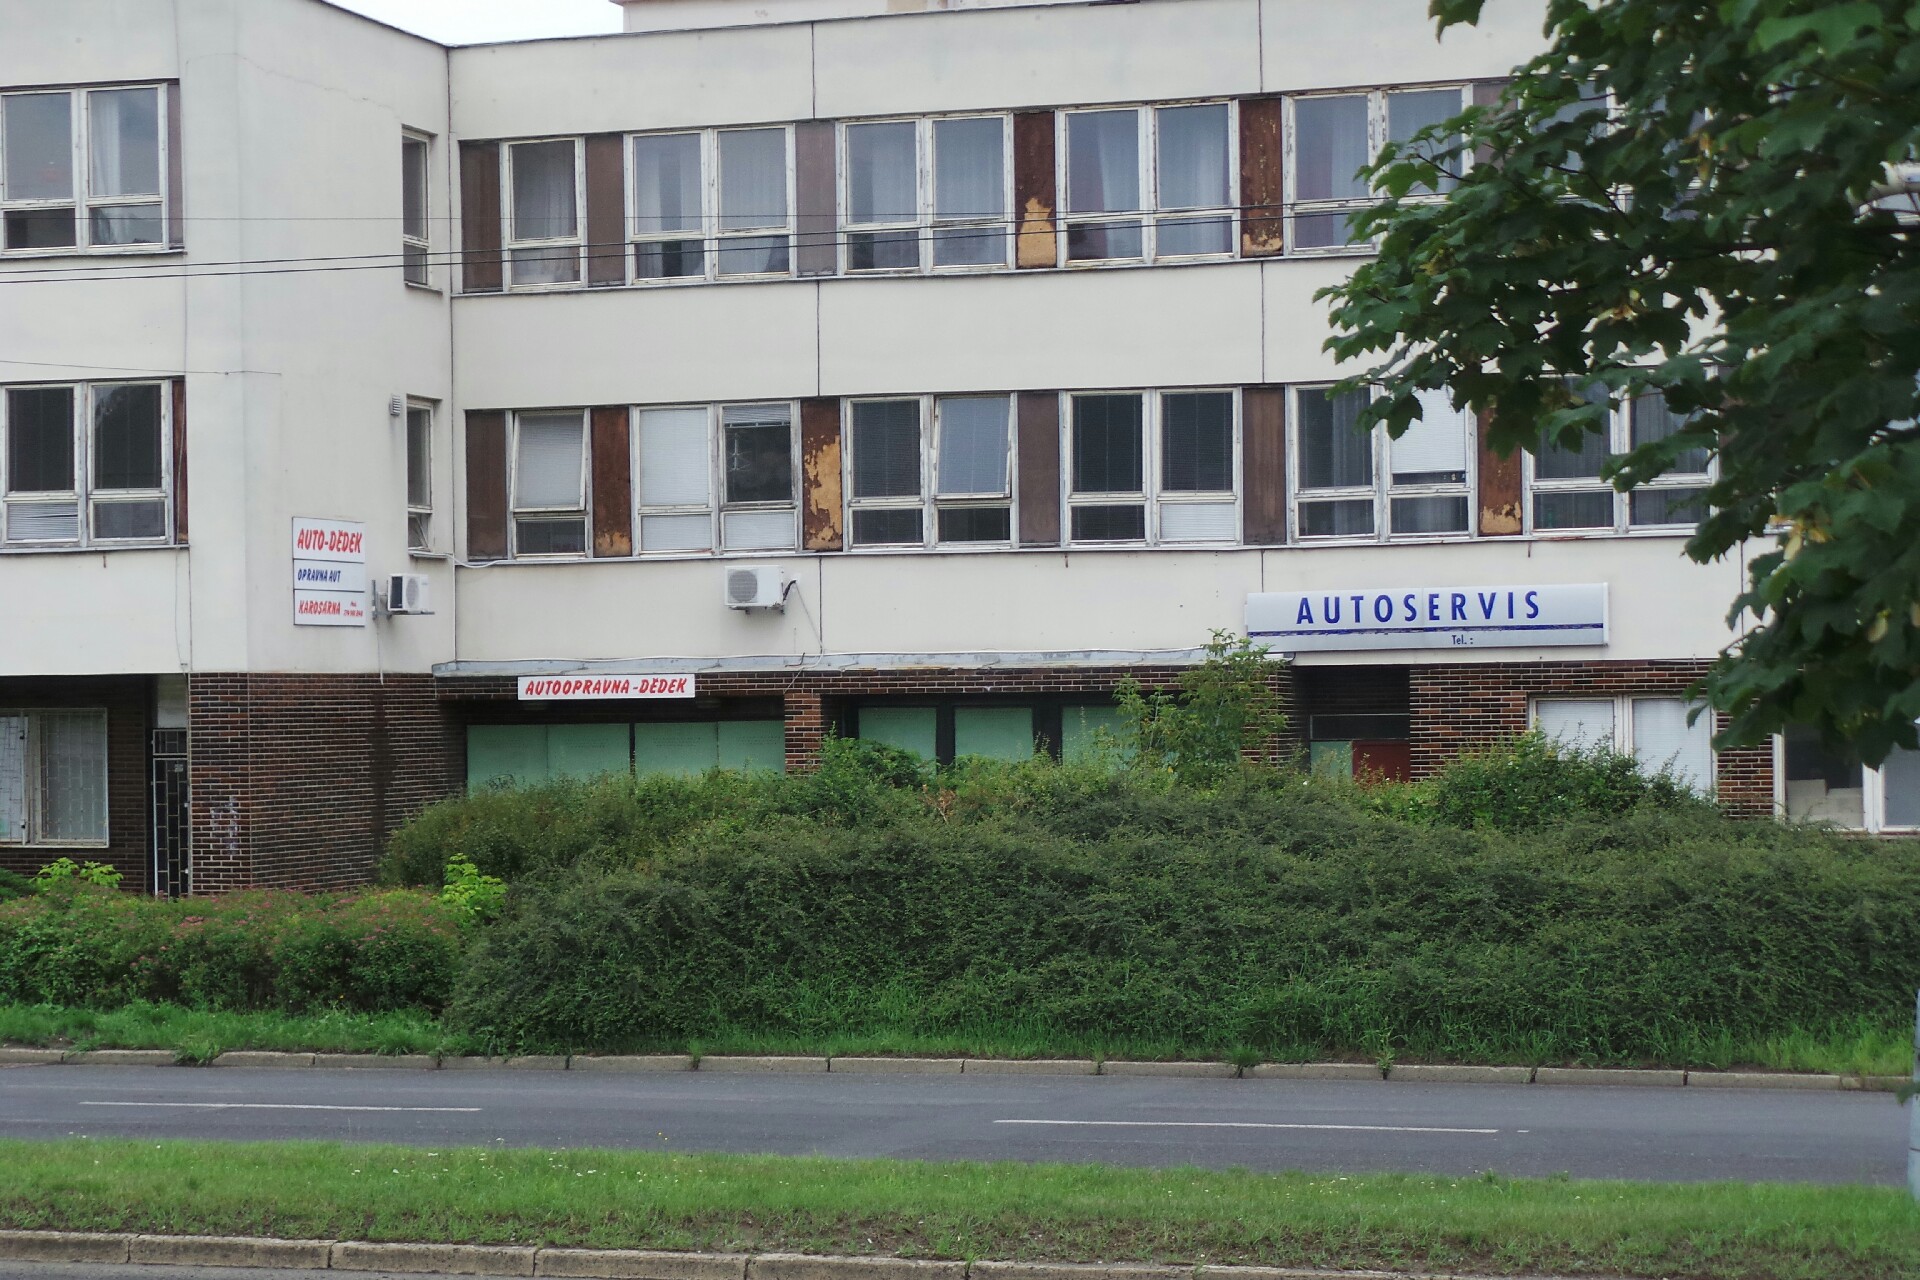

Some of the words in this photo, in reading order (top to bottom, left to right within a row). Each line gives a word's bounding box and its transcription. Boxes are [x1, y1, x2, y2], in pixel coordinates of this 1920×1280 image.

[298, 569, 328, 582] OPRAVNA
[329, 571, 341, 582] AUT
[1296, 591, 1540, 624] AUTOSERVIS
[526, 679, 629, 695] AUTOOPRAVNA
